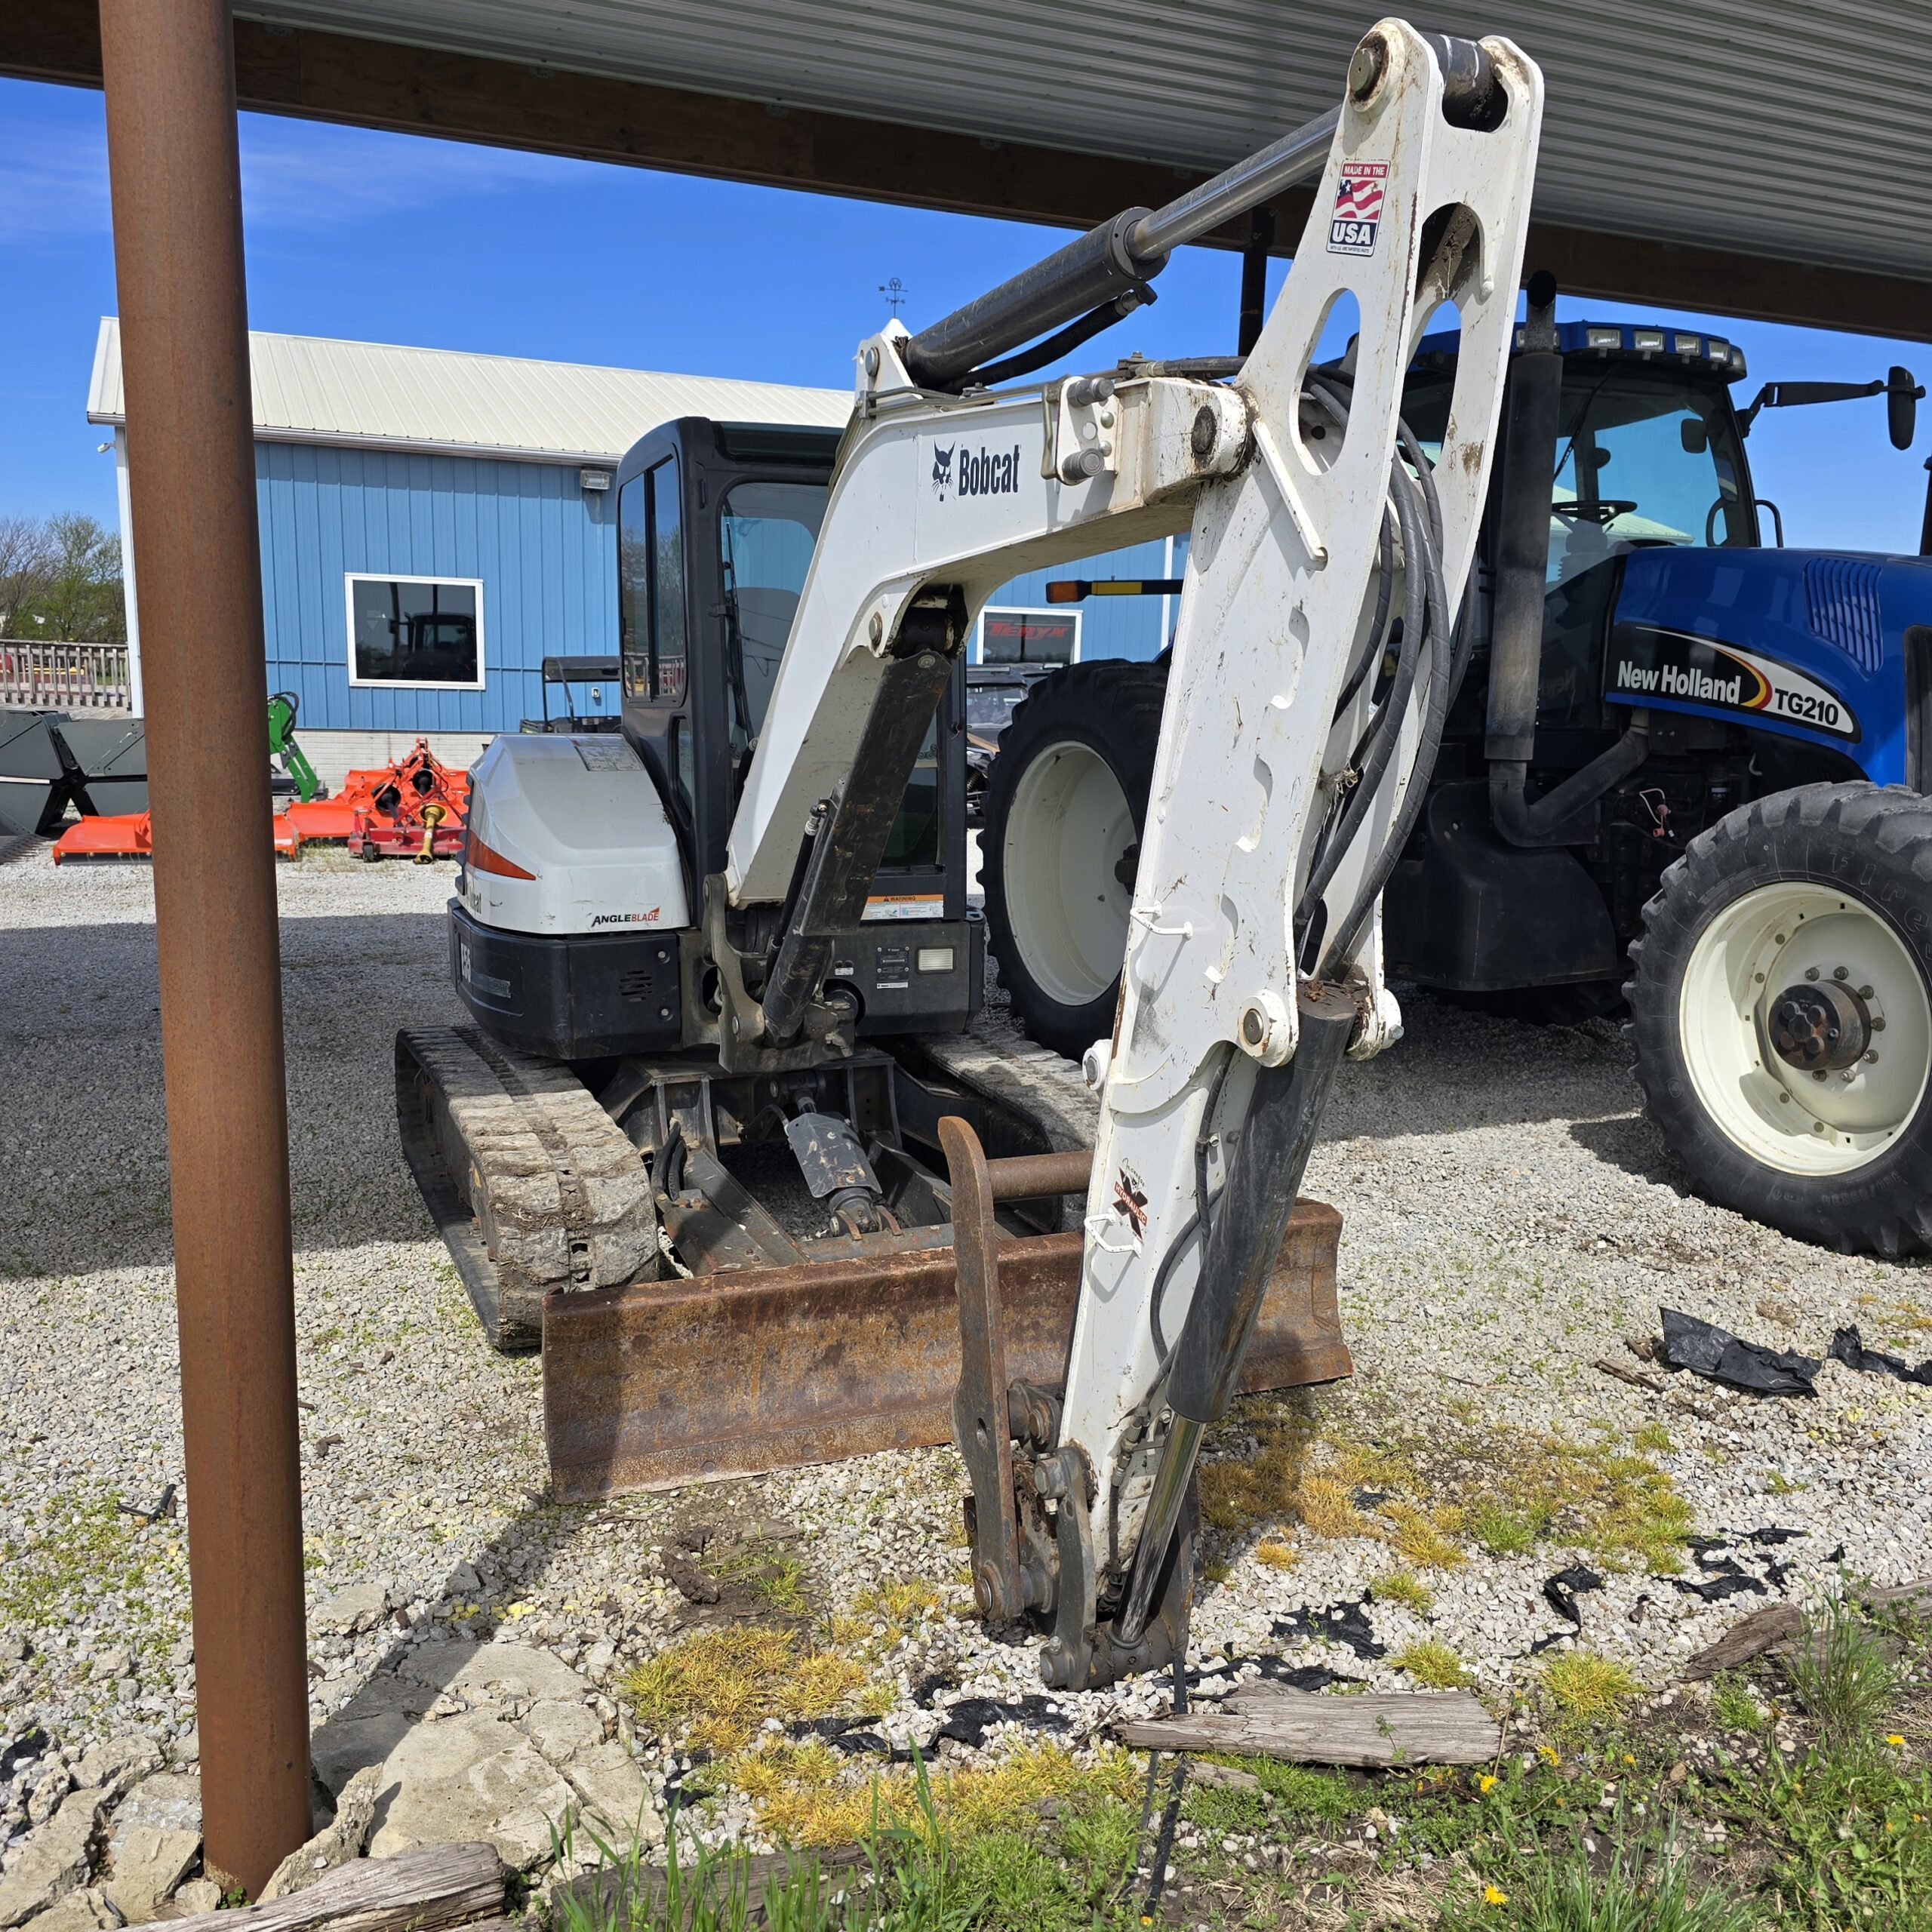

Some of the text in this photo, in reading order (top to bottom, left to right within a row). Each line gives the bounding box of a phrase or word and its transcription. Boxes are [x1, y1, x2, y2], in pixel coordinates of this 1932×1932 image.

[1344, 165, 1385, 175] MADE IN THE
[1332, 222, 1371, 245] USA
[958, 445, 1020, 496] Bobcat
[1617, 660, 1741, 704] New Holland
[1774, 688, 1838, 726] TG210
[591, 912, 659, 928] ANGLEBLADE
[1115, 1183, 1147, 1223] HYDRAULIC
